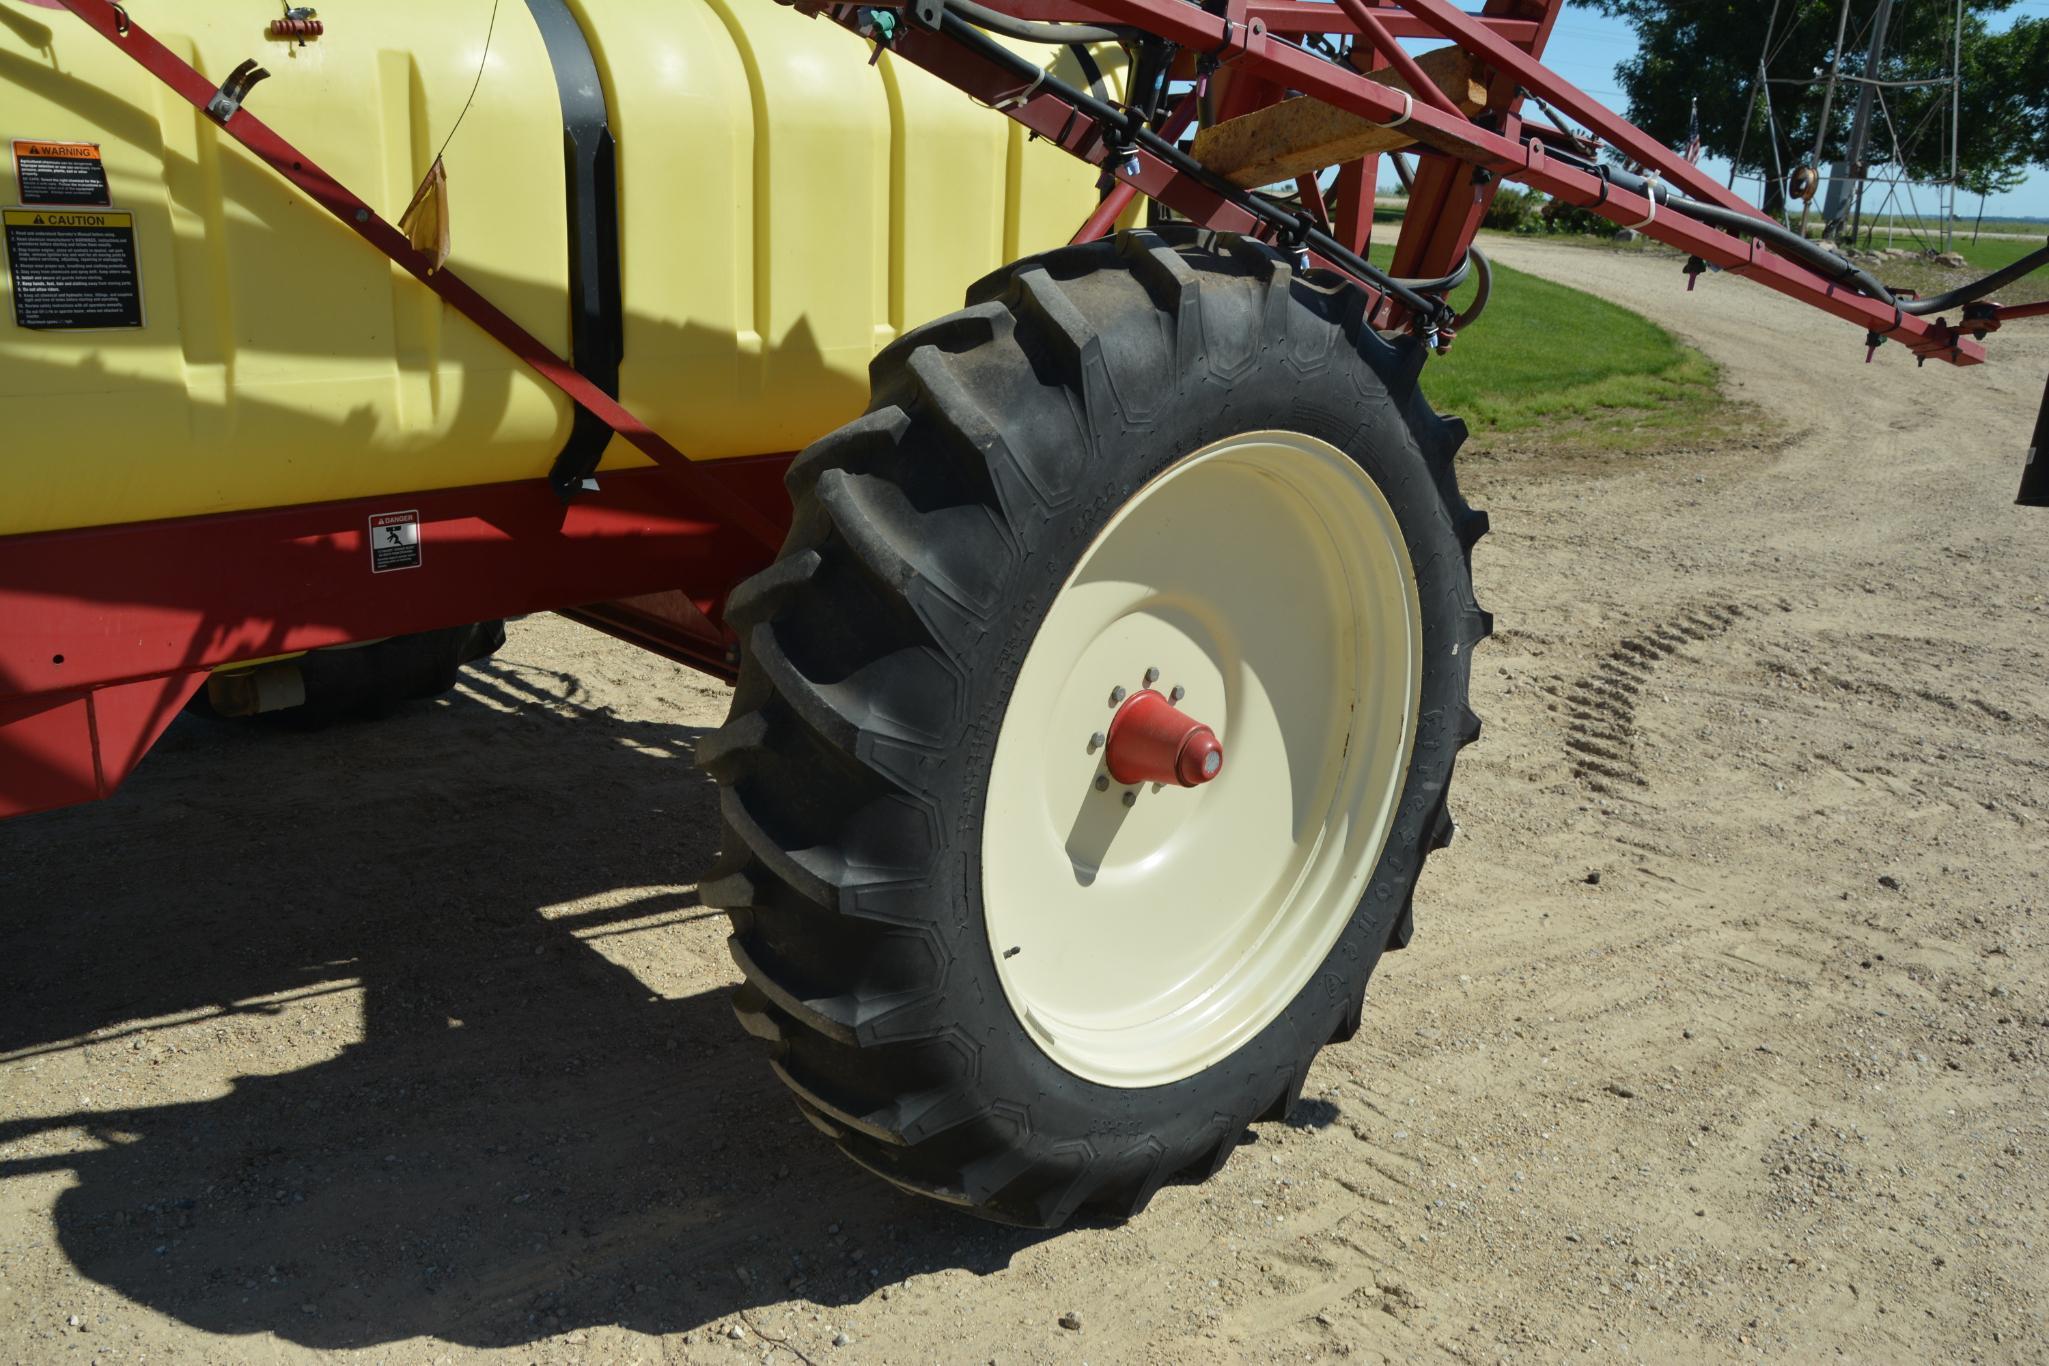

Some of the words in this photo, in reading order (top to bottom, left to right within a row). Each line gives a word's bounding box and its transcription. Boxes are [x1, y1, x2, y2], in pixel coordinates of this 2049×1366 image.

[41, 147, 90, 156] WARNING
[48, 215, 105, 226] CAUTION
[384, 515, 412, 524] DANGER
